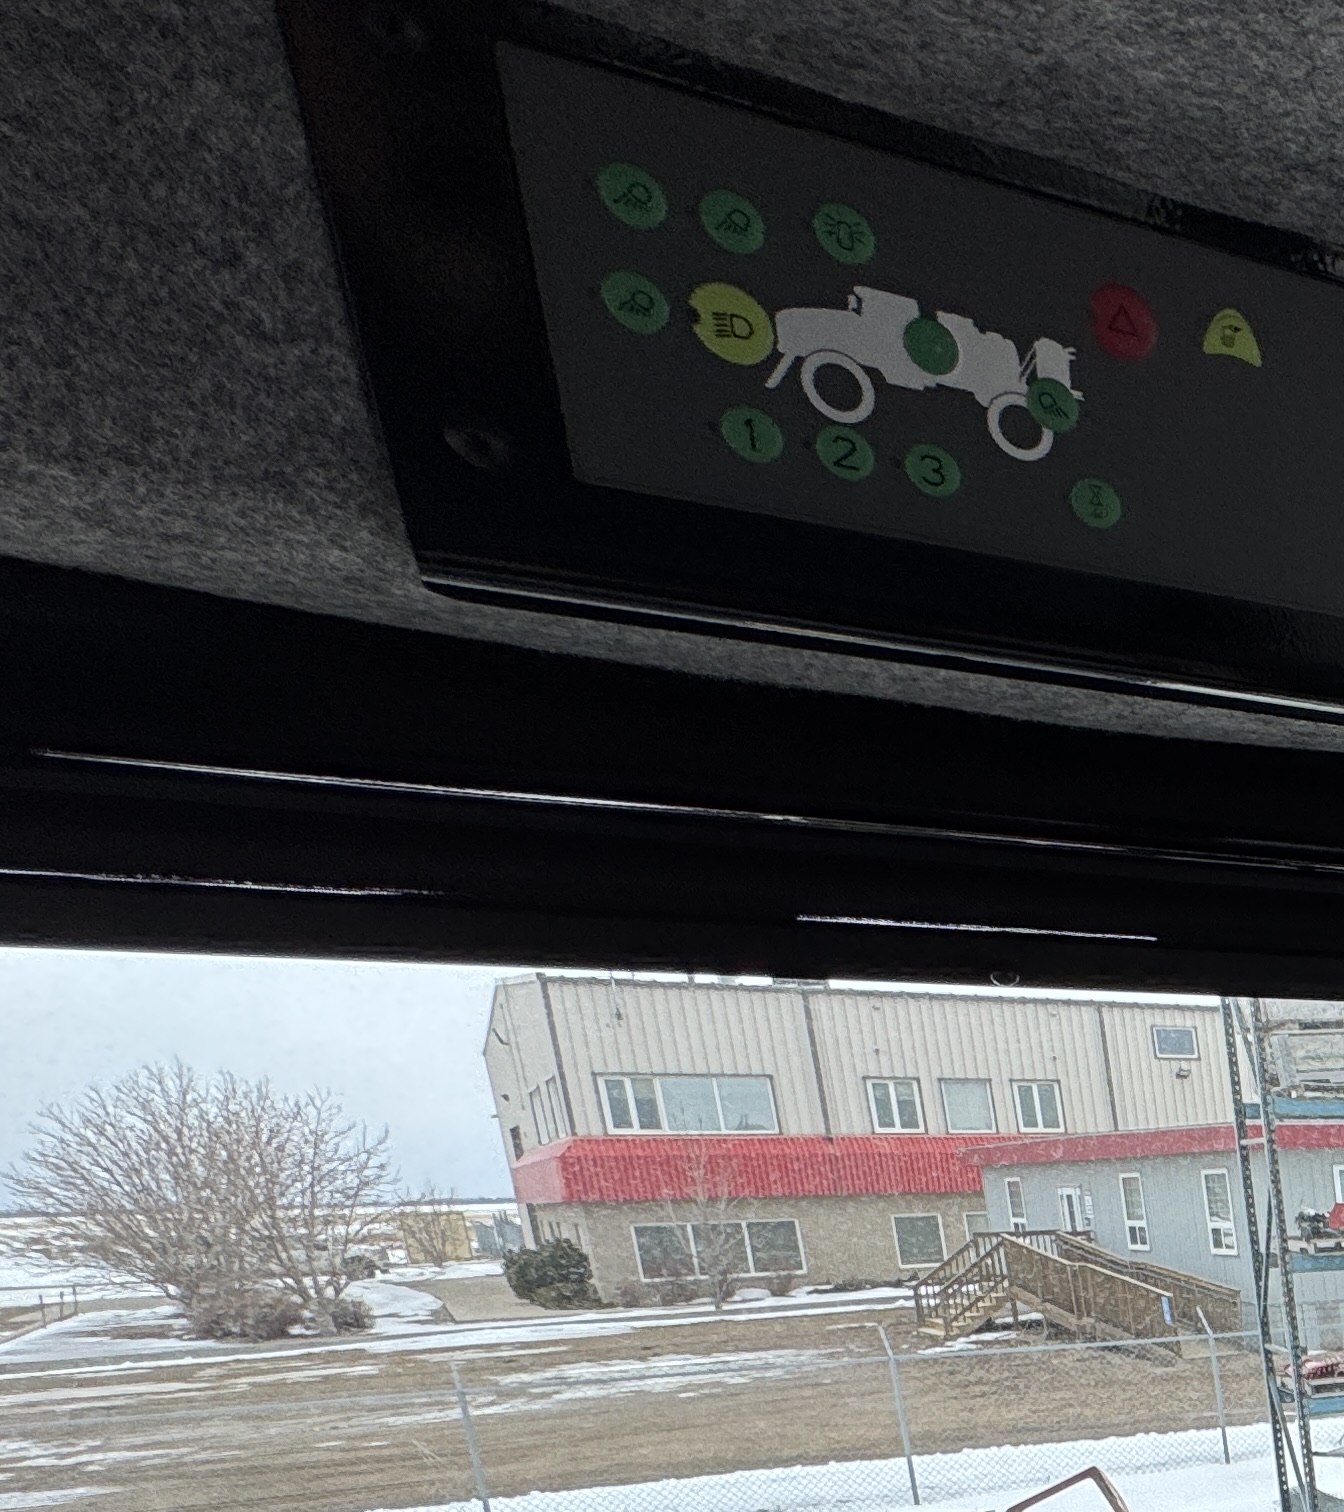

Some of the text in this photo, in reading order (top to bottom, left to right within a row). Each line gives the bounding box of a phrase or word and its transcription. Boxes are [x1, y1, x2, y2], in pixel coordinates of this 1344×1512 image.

[743, 417, 758, 450] 1
[832, 435, 861, 472] 2
[919, 454, 946, 487] 3
